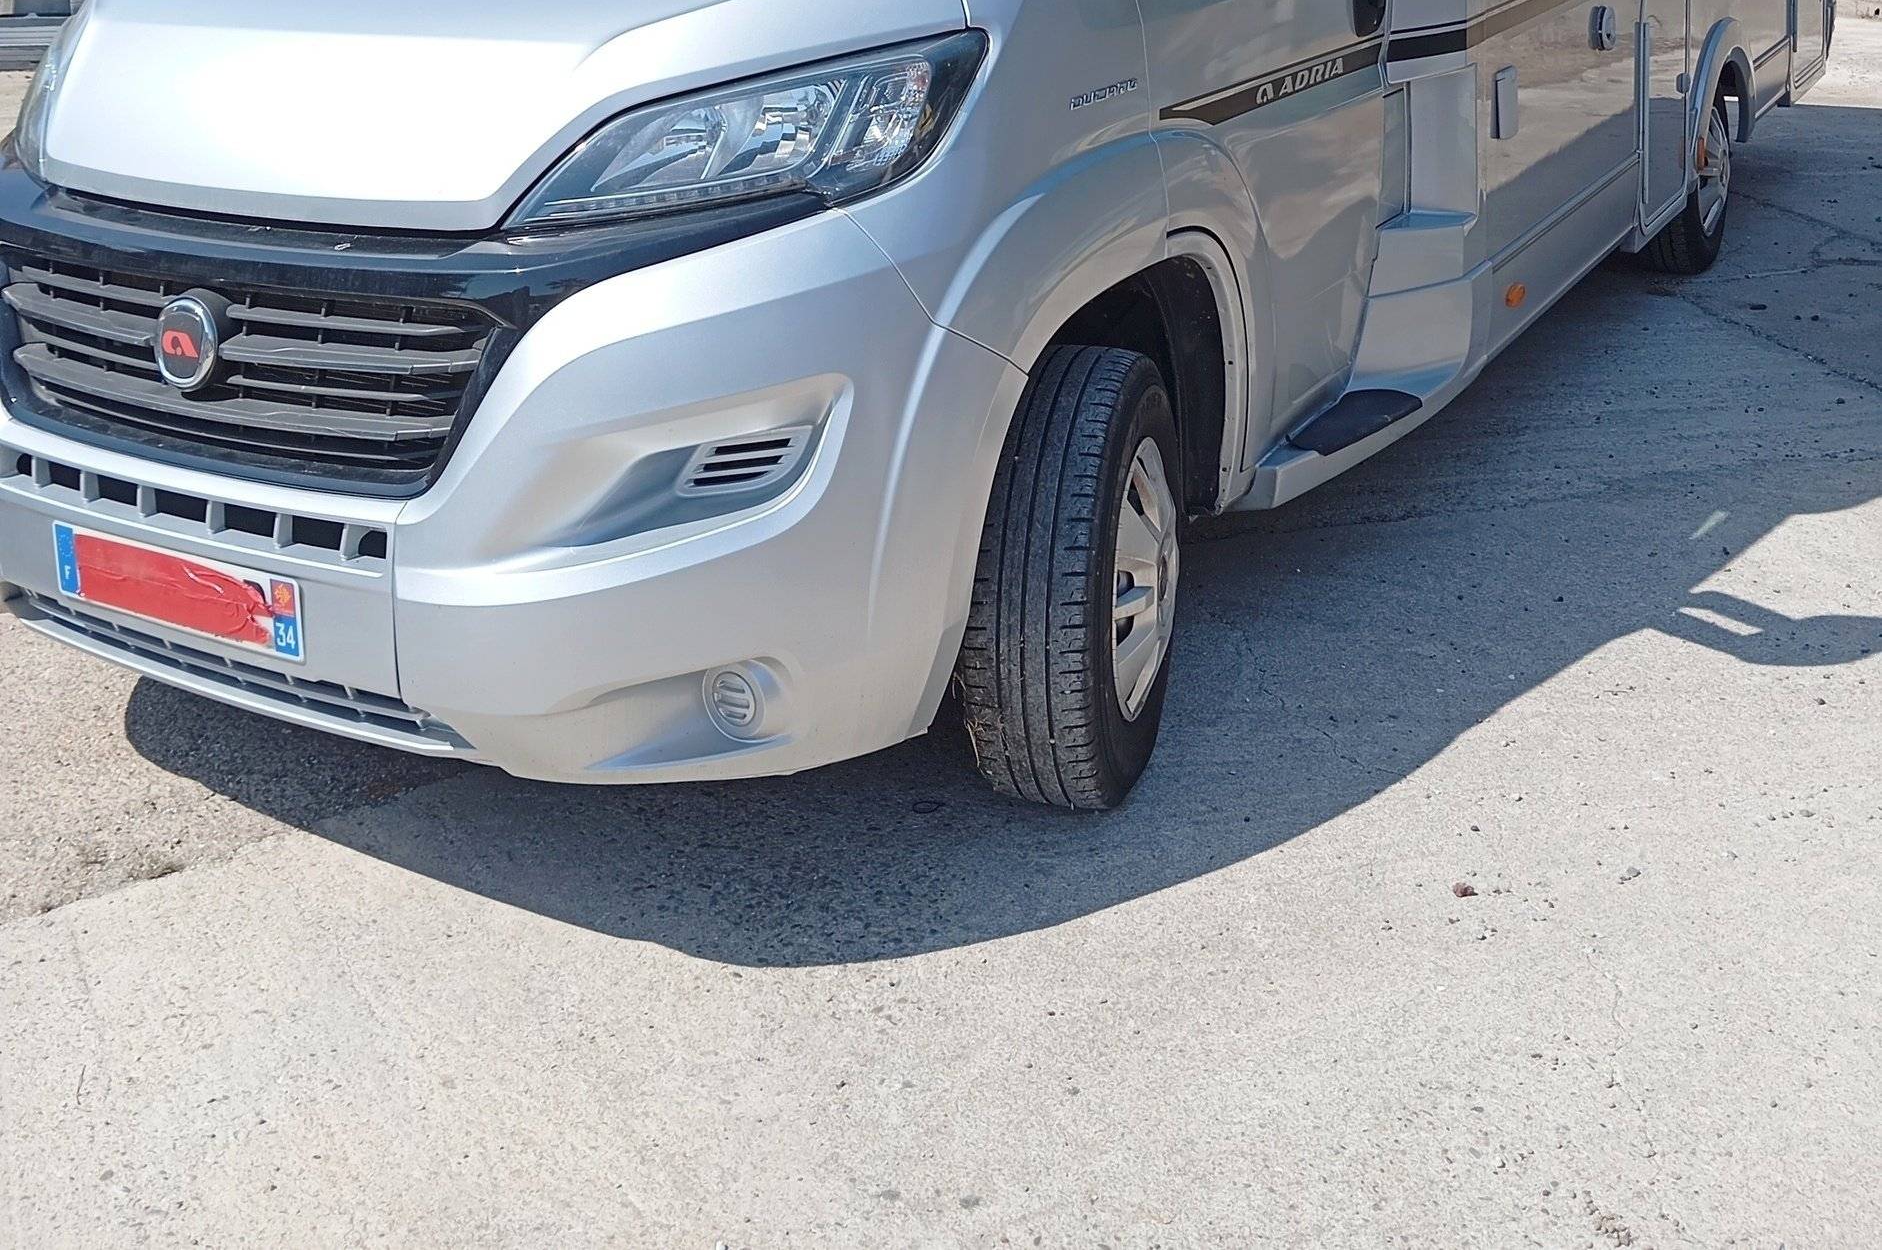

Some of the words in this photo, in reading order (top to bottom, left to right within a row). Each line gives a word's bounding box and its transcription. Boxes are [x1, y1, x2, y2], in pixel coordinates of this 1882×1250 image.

[1279, 57, 1344, 96] ADRIA
[64, 564, 72, 580] F
[275, 621, 296, 650] 34
